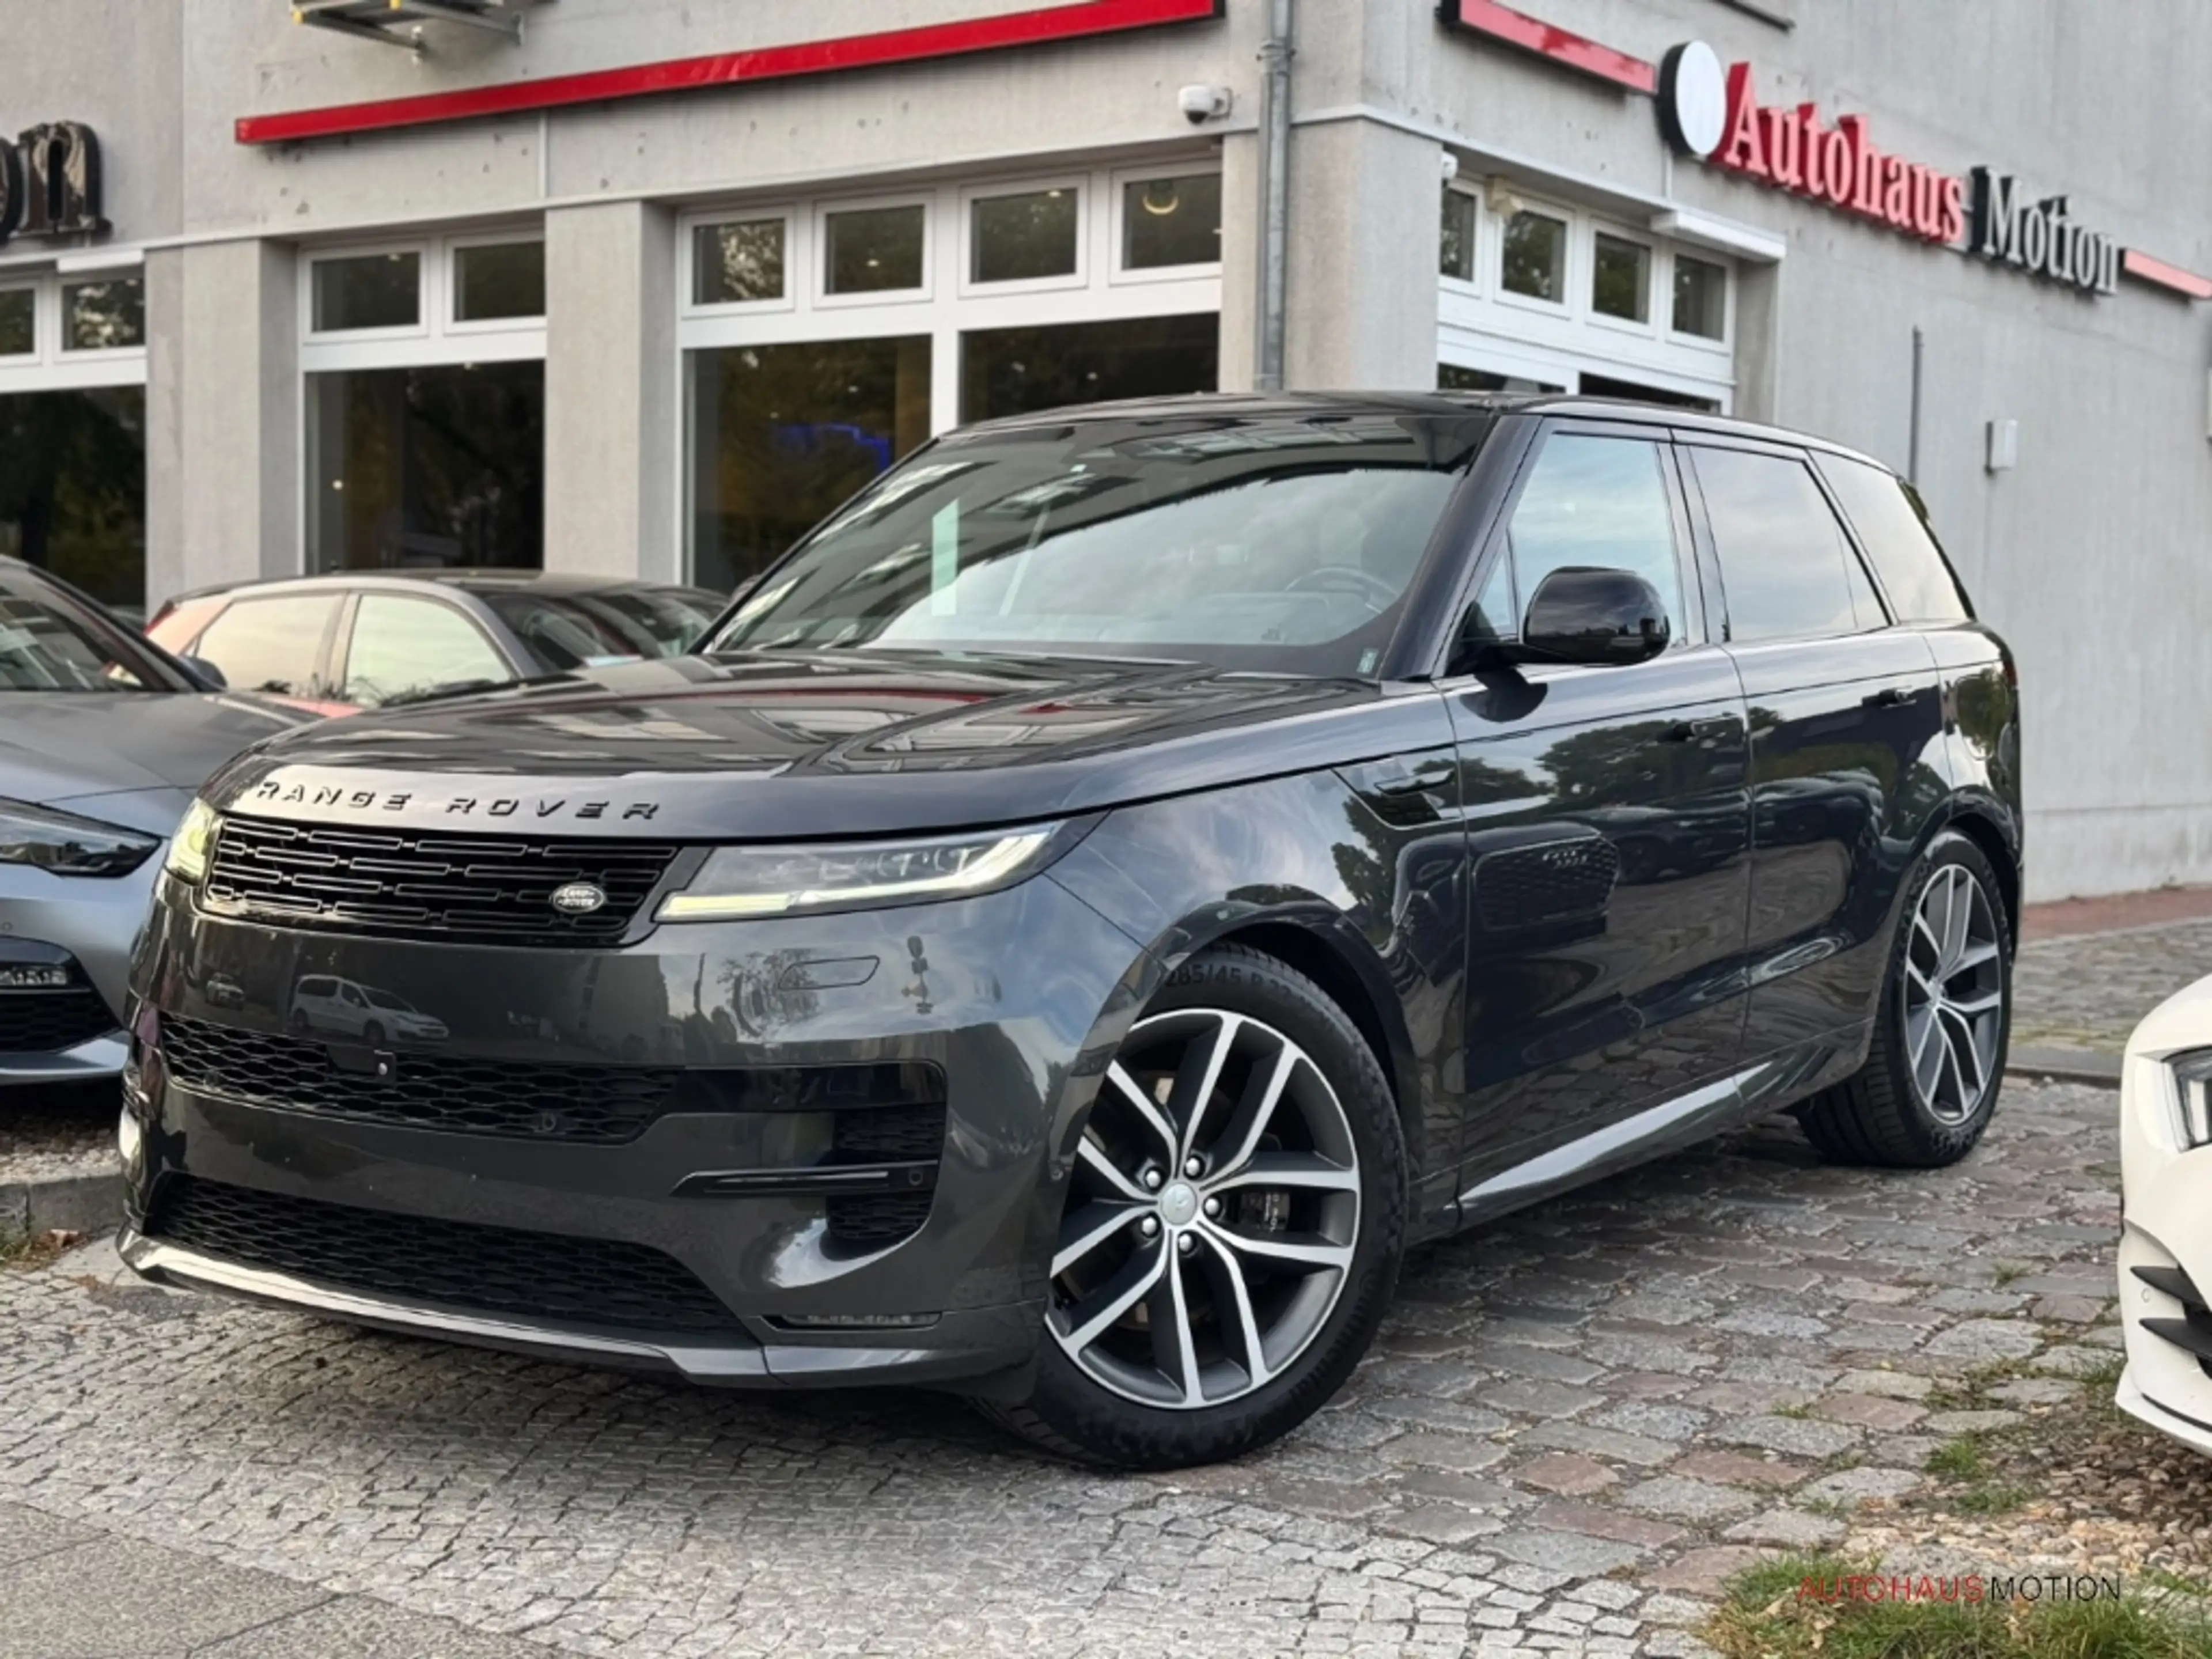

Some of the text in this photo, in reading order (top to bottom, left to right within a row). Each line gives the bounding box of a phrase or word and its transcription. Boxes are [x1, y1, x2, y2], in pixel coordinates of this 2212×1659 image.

[1712, 62, 2118, 295] Autohaus Motion
[257, 781, 660, 820] RANGE ROVER
